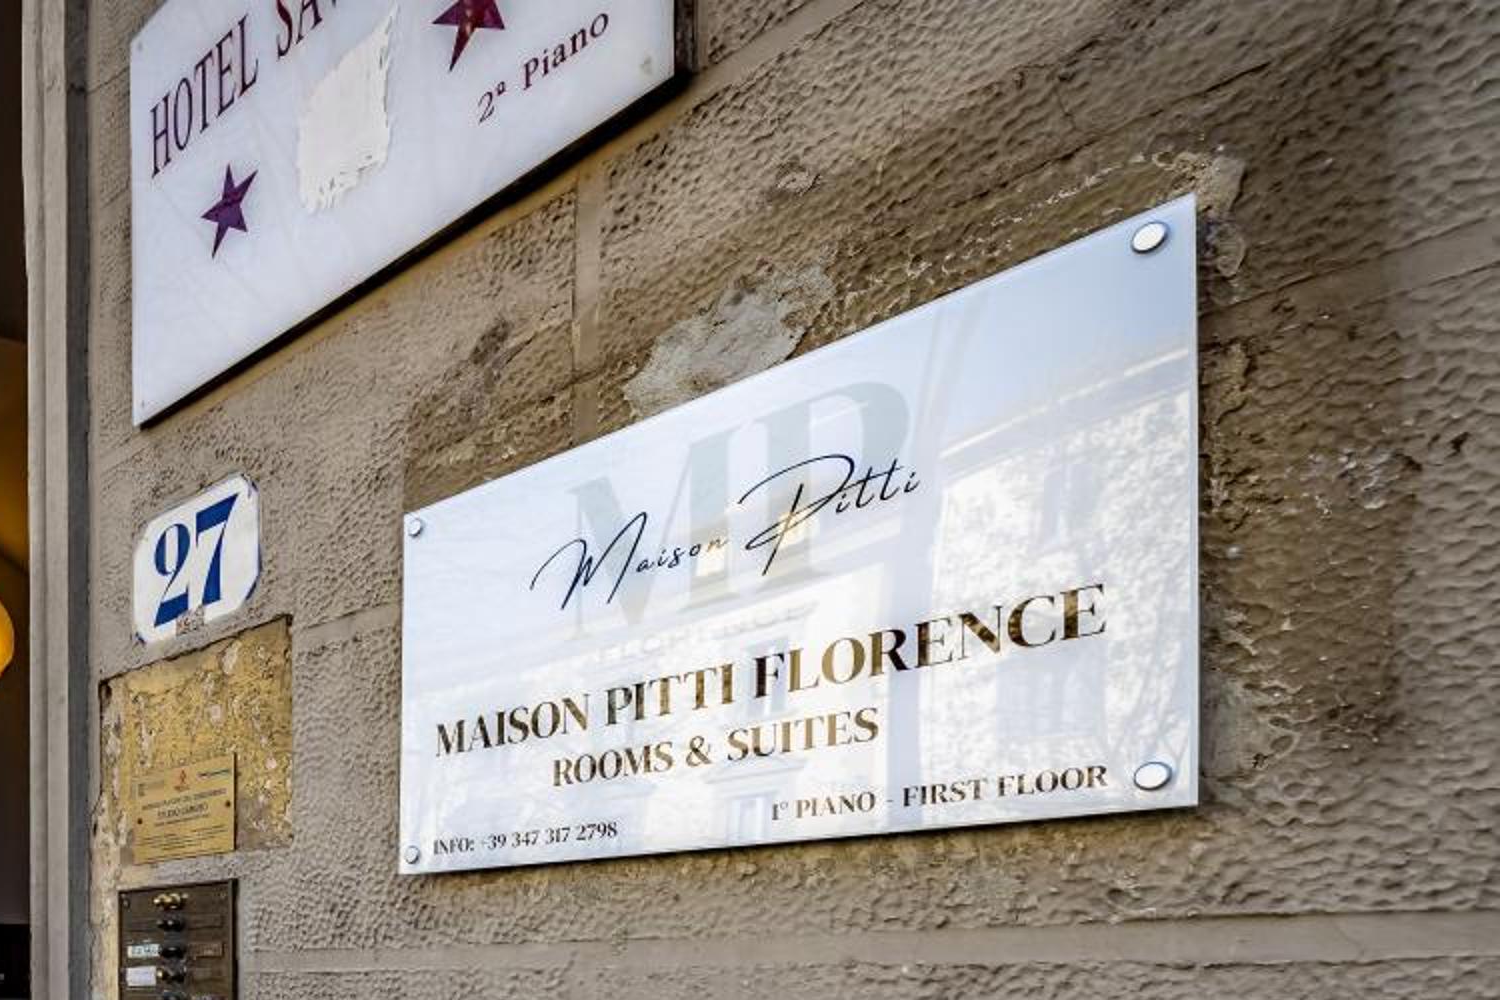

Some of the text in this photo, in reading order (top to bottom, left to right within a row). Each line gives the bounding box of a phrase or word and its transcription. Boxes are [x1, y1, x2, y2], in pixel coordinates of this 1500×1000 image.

[150, 12, 259, 179] HOTEL
[523, 13, 609, 91] Piano
[153, 491, 240, 628] 27
[529, 453, 922, 610] Maison Pitti
[435, 583, 1108, 758] MAISON PITTI FLORENCE
[552, 706, 880, 787] ROOMS & SUITES
[795, 790, 877, 819] PIANO
[902, 777, 990, 808] FIRST
[999, 764, 1109, 798] FLOOR
[433, 837, 476, 856] INFO:
[511, 830, 540, 848] 347
[545, 827, 571, 844] 317
[576, 822, 619, 842] 2798
